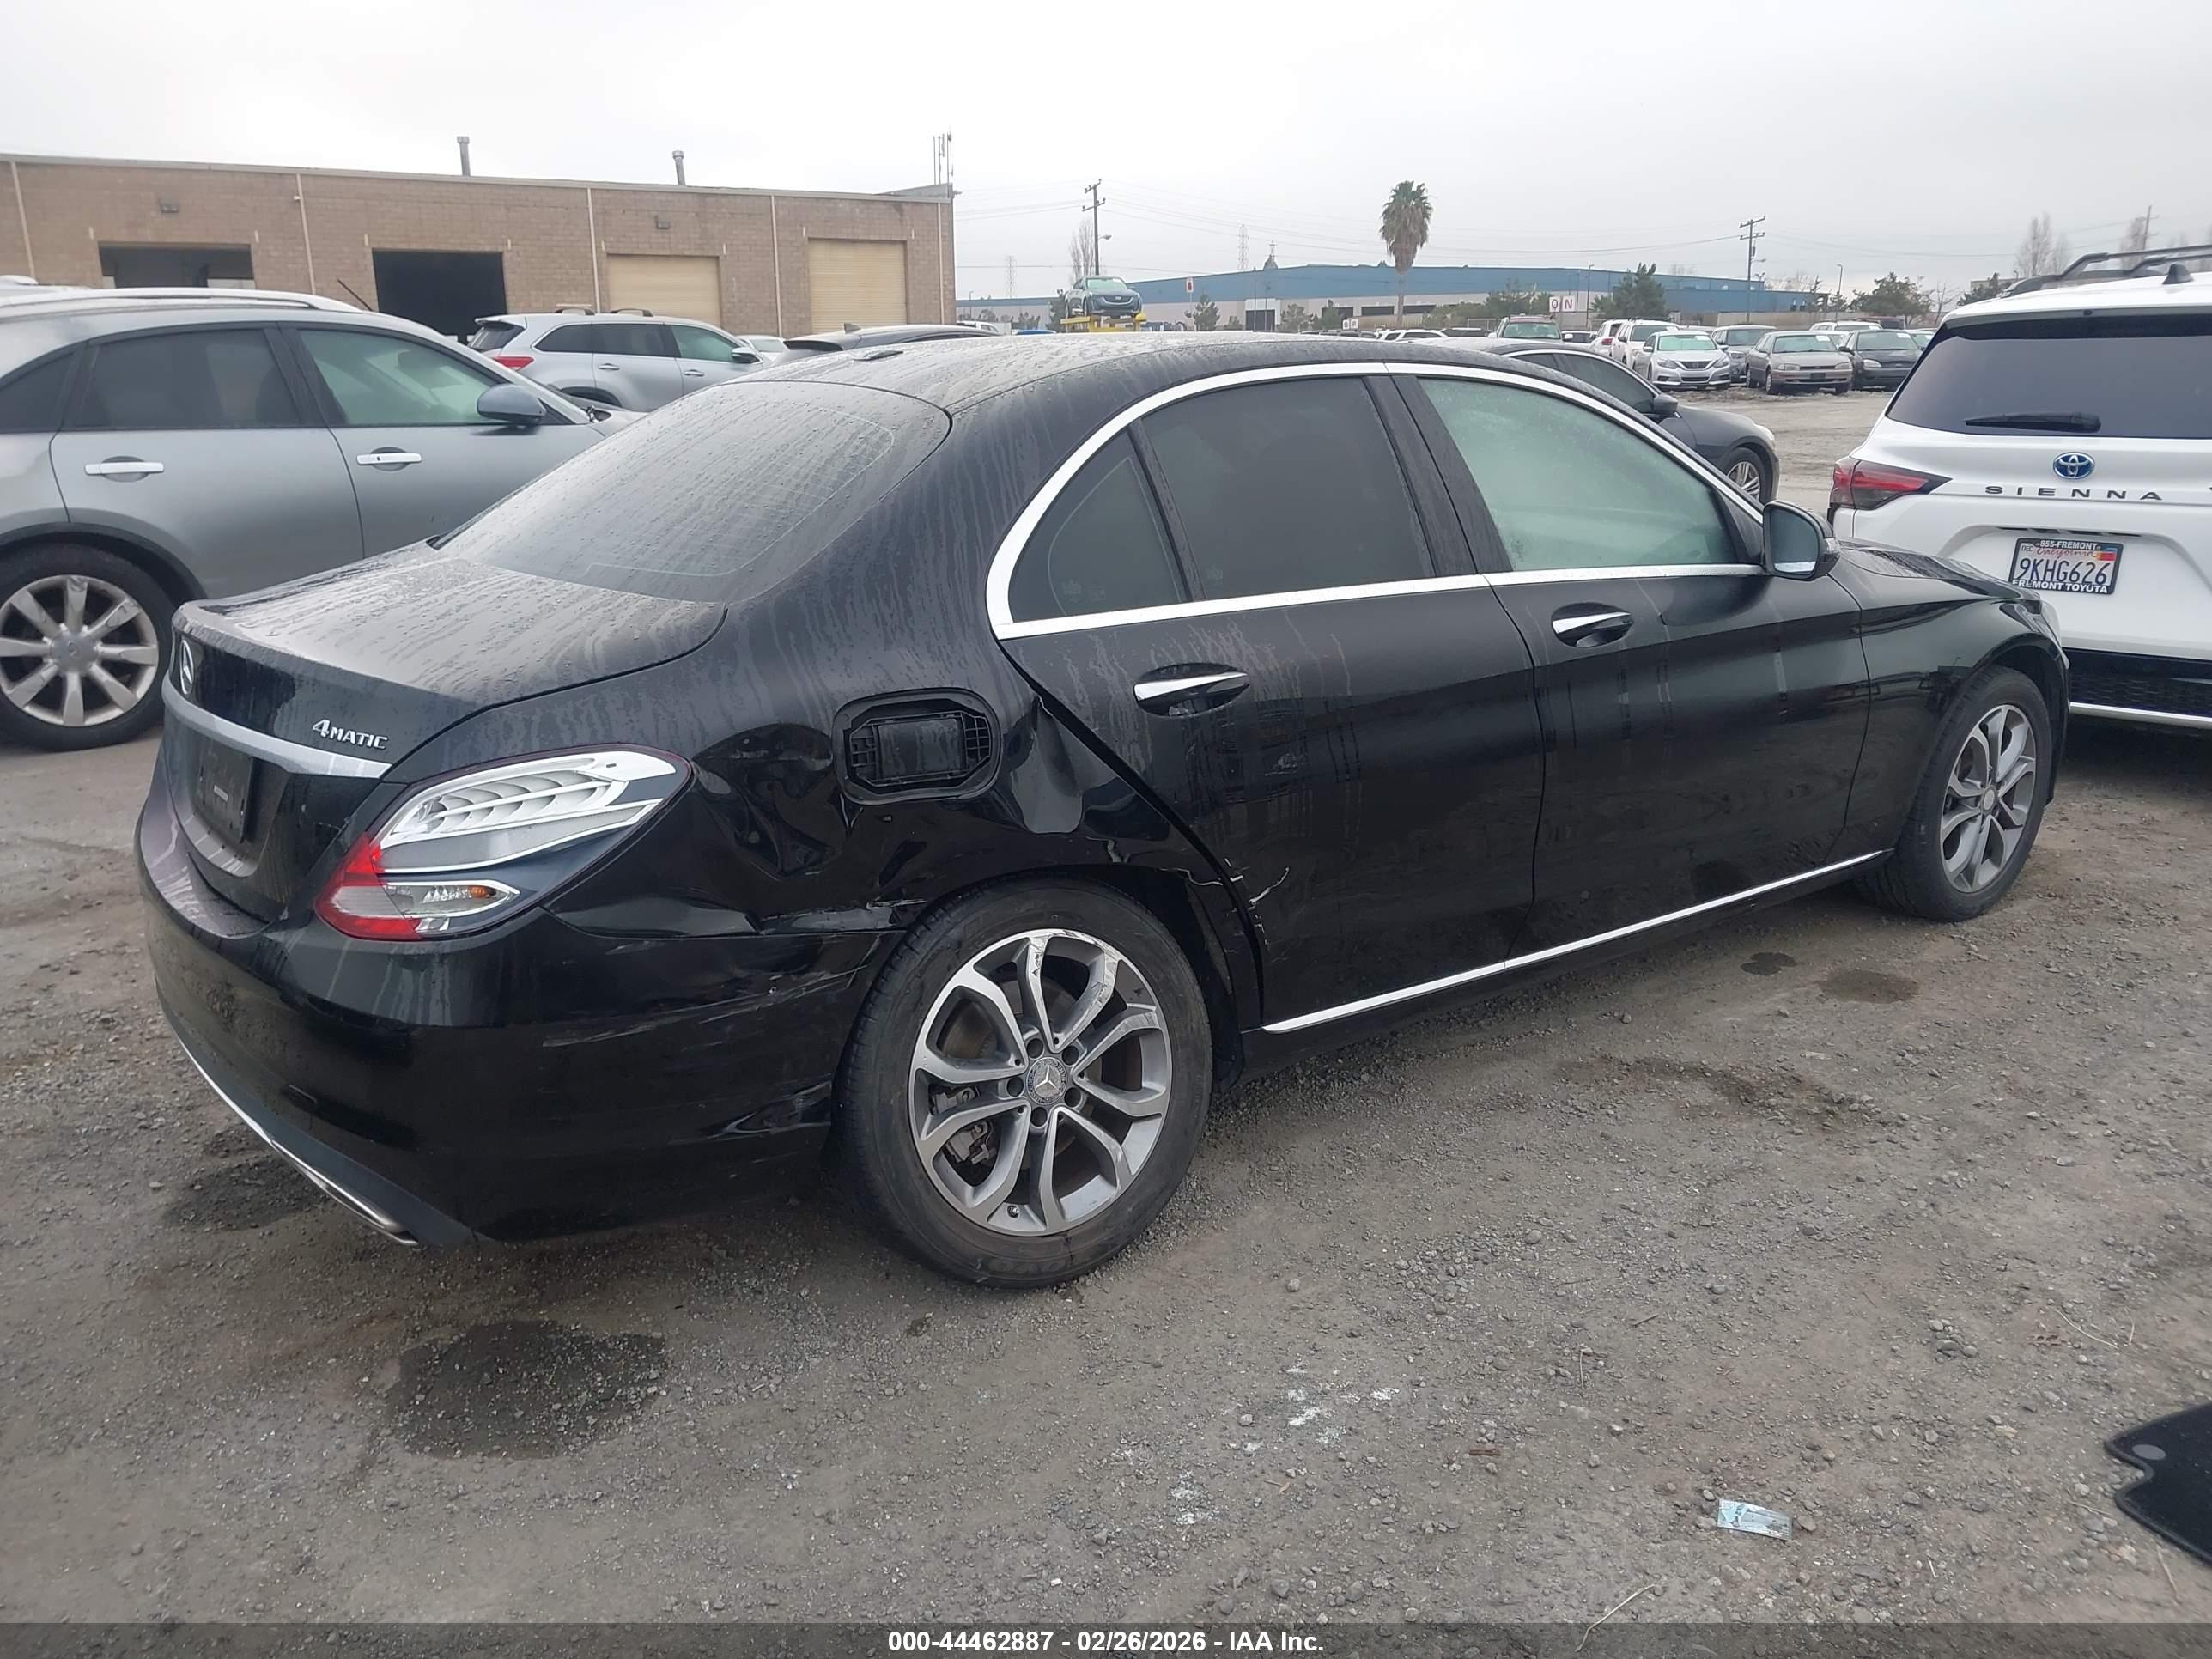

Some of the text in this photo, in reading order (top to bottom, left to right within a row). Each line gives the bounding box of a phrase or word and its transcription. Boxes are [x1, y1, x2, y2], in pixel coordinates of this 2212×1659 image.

[1984, 485, 2163, 501] SIENNA
[2016, 557, 2111, 586] 9KHG626
[2065, 582, 2108, 594] TOYOTA
[312, 719, 388, 750] 4MATIC
